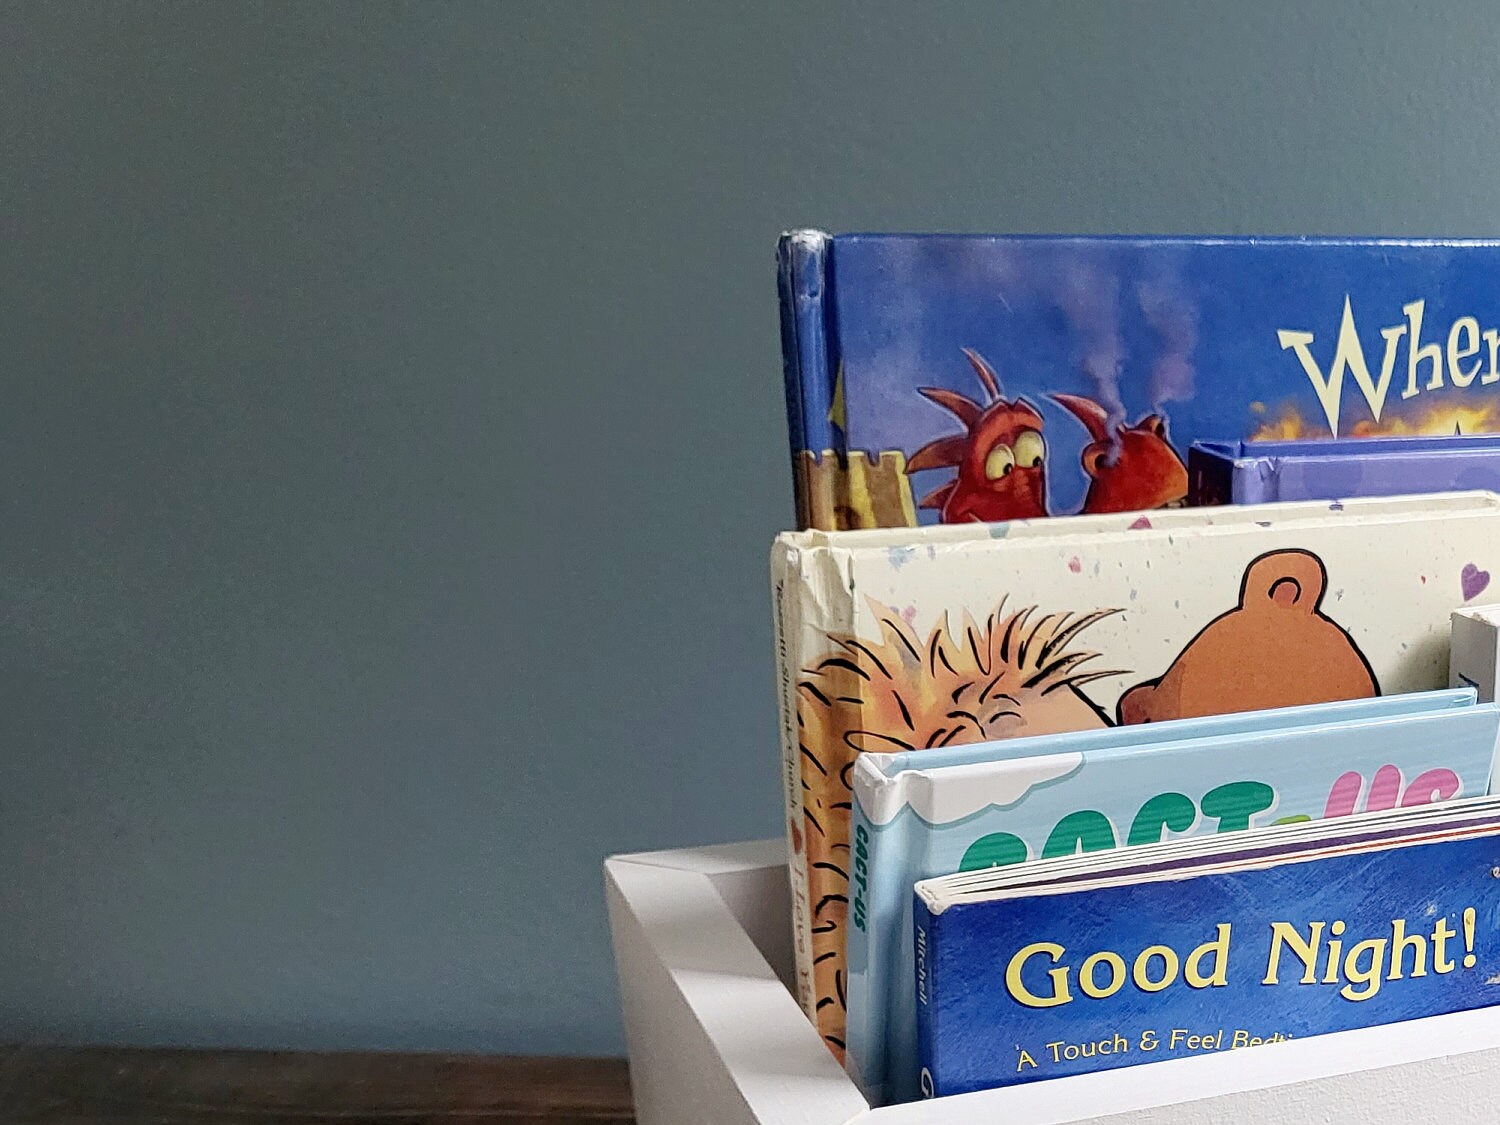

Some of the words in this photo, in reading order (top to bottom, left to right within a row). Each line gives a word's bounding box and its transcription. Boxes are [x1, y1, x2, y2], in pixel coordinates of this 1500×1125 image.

[854, 824, 869, 933] CACT-US
[915, 925, 927, 1006] Mitchell
[1005, 922, 1232, 1008] Good
[1262, 907, 1477, 1002] Night!
[1016, 1047, 1038, 1072] A
[1046, 1032, 1128, 1063] Touch
[1139, 1029, 1159, 1051] &
[1168, 1029, 1223, 1051] Feel
[1230, 1029, 1293, 1051] Bed
